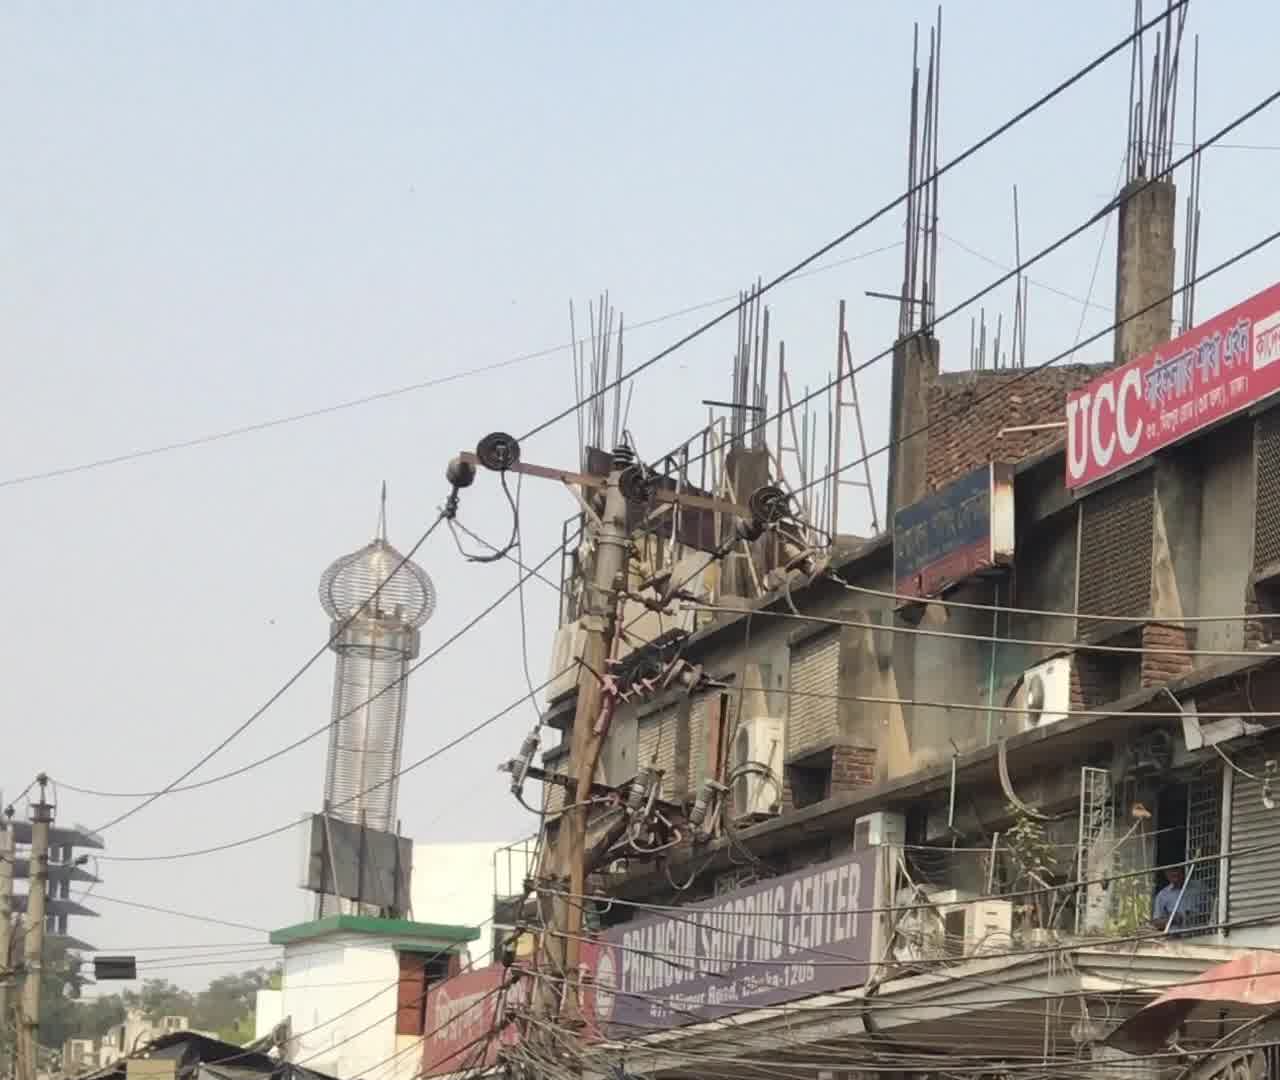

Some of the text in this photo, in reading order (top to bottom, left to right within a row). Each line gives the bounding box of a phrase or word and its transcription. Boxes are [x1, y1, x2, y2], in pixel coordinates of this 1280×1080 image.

[1066, 367, 1143, 479] UCC
[622, 861, 862, 994] PRIANGON SHOPPING CENTER
